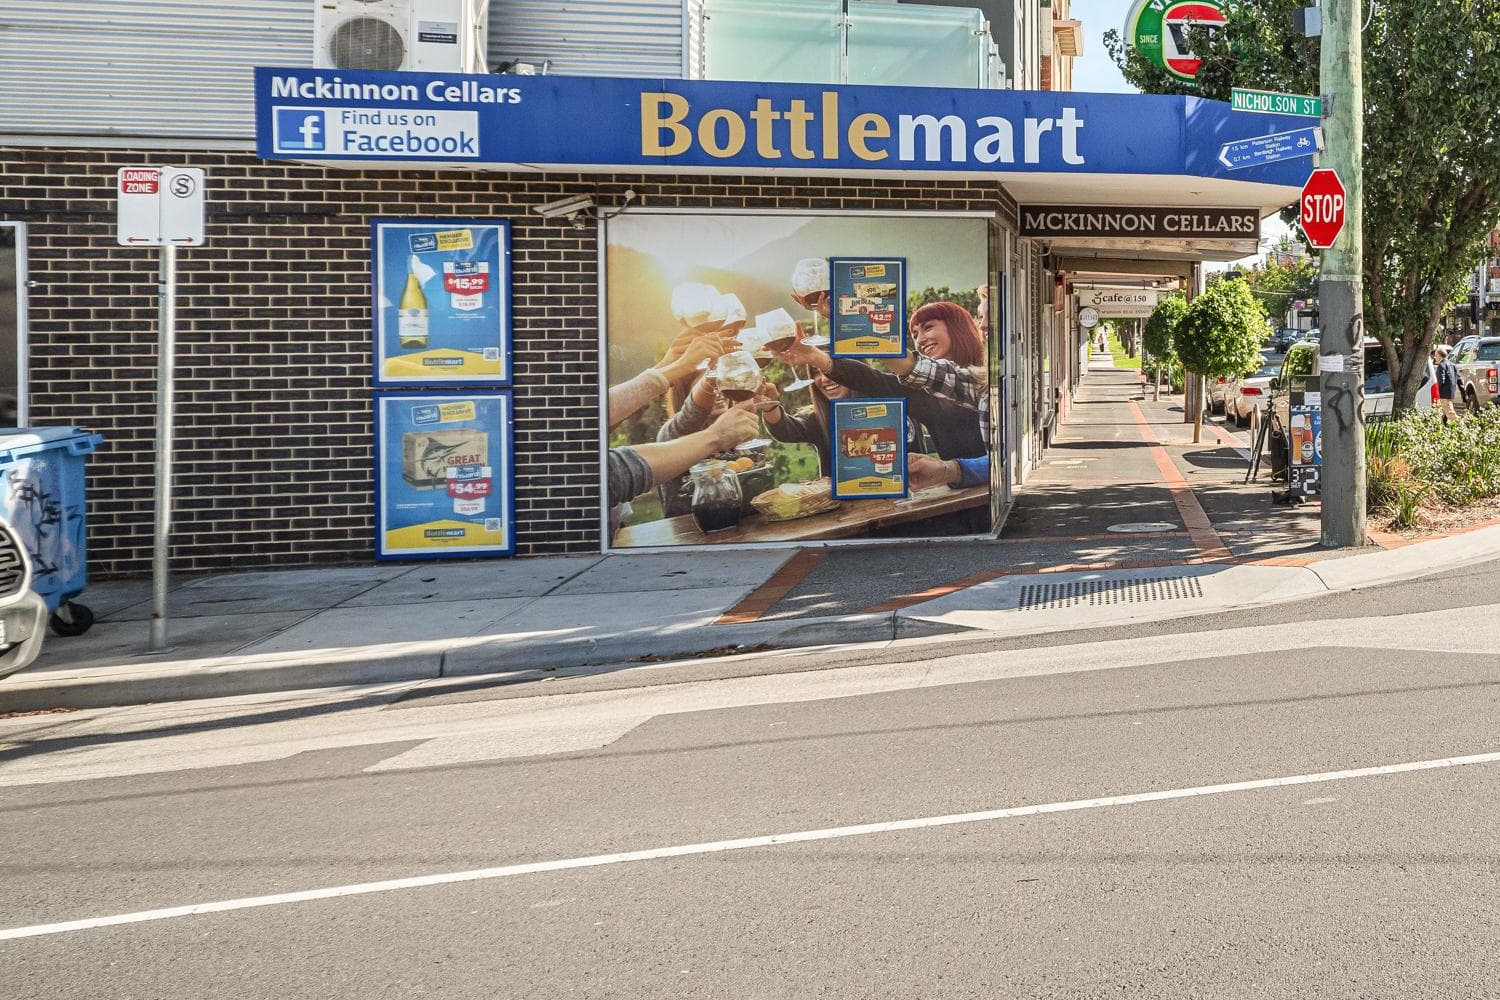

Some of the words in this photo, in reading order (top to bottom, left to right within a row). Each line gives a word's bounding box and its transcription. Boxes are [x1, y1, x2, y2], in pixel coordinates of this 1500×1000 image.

[271, 76, 422, 101] Mckinnon
[426, 79, 521, 104] Cellars
[1234, 92, 1297, 113] NICHOLSON
[1303, 99, 1316, 115] ST
[342, 110, 381, 126] Find
[387, 114, 408, 127] us
[414, 114, 436, 127] on
[640, 91, 1086, 165] Bottlemart
[343, 129, 475, 154] Facebook
[122, 171, 158, 182] LOADING
[126, 183, 154, 193] ZONE
[1304, 194, 1343, 223] STOP
[1025, 212, 1157, 232] MCKINNON
[1163, 213, 1255, 233] CELLARS
[447, 454, 481, 465] GREAT
